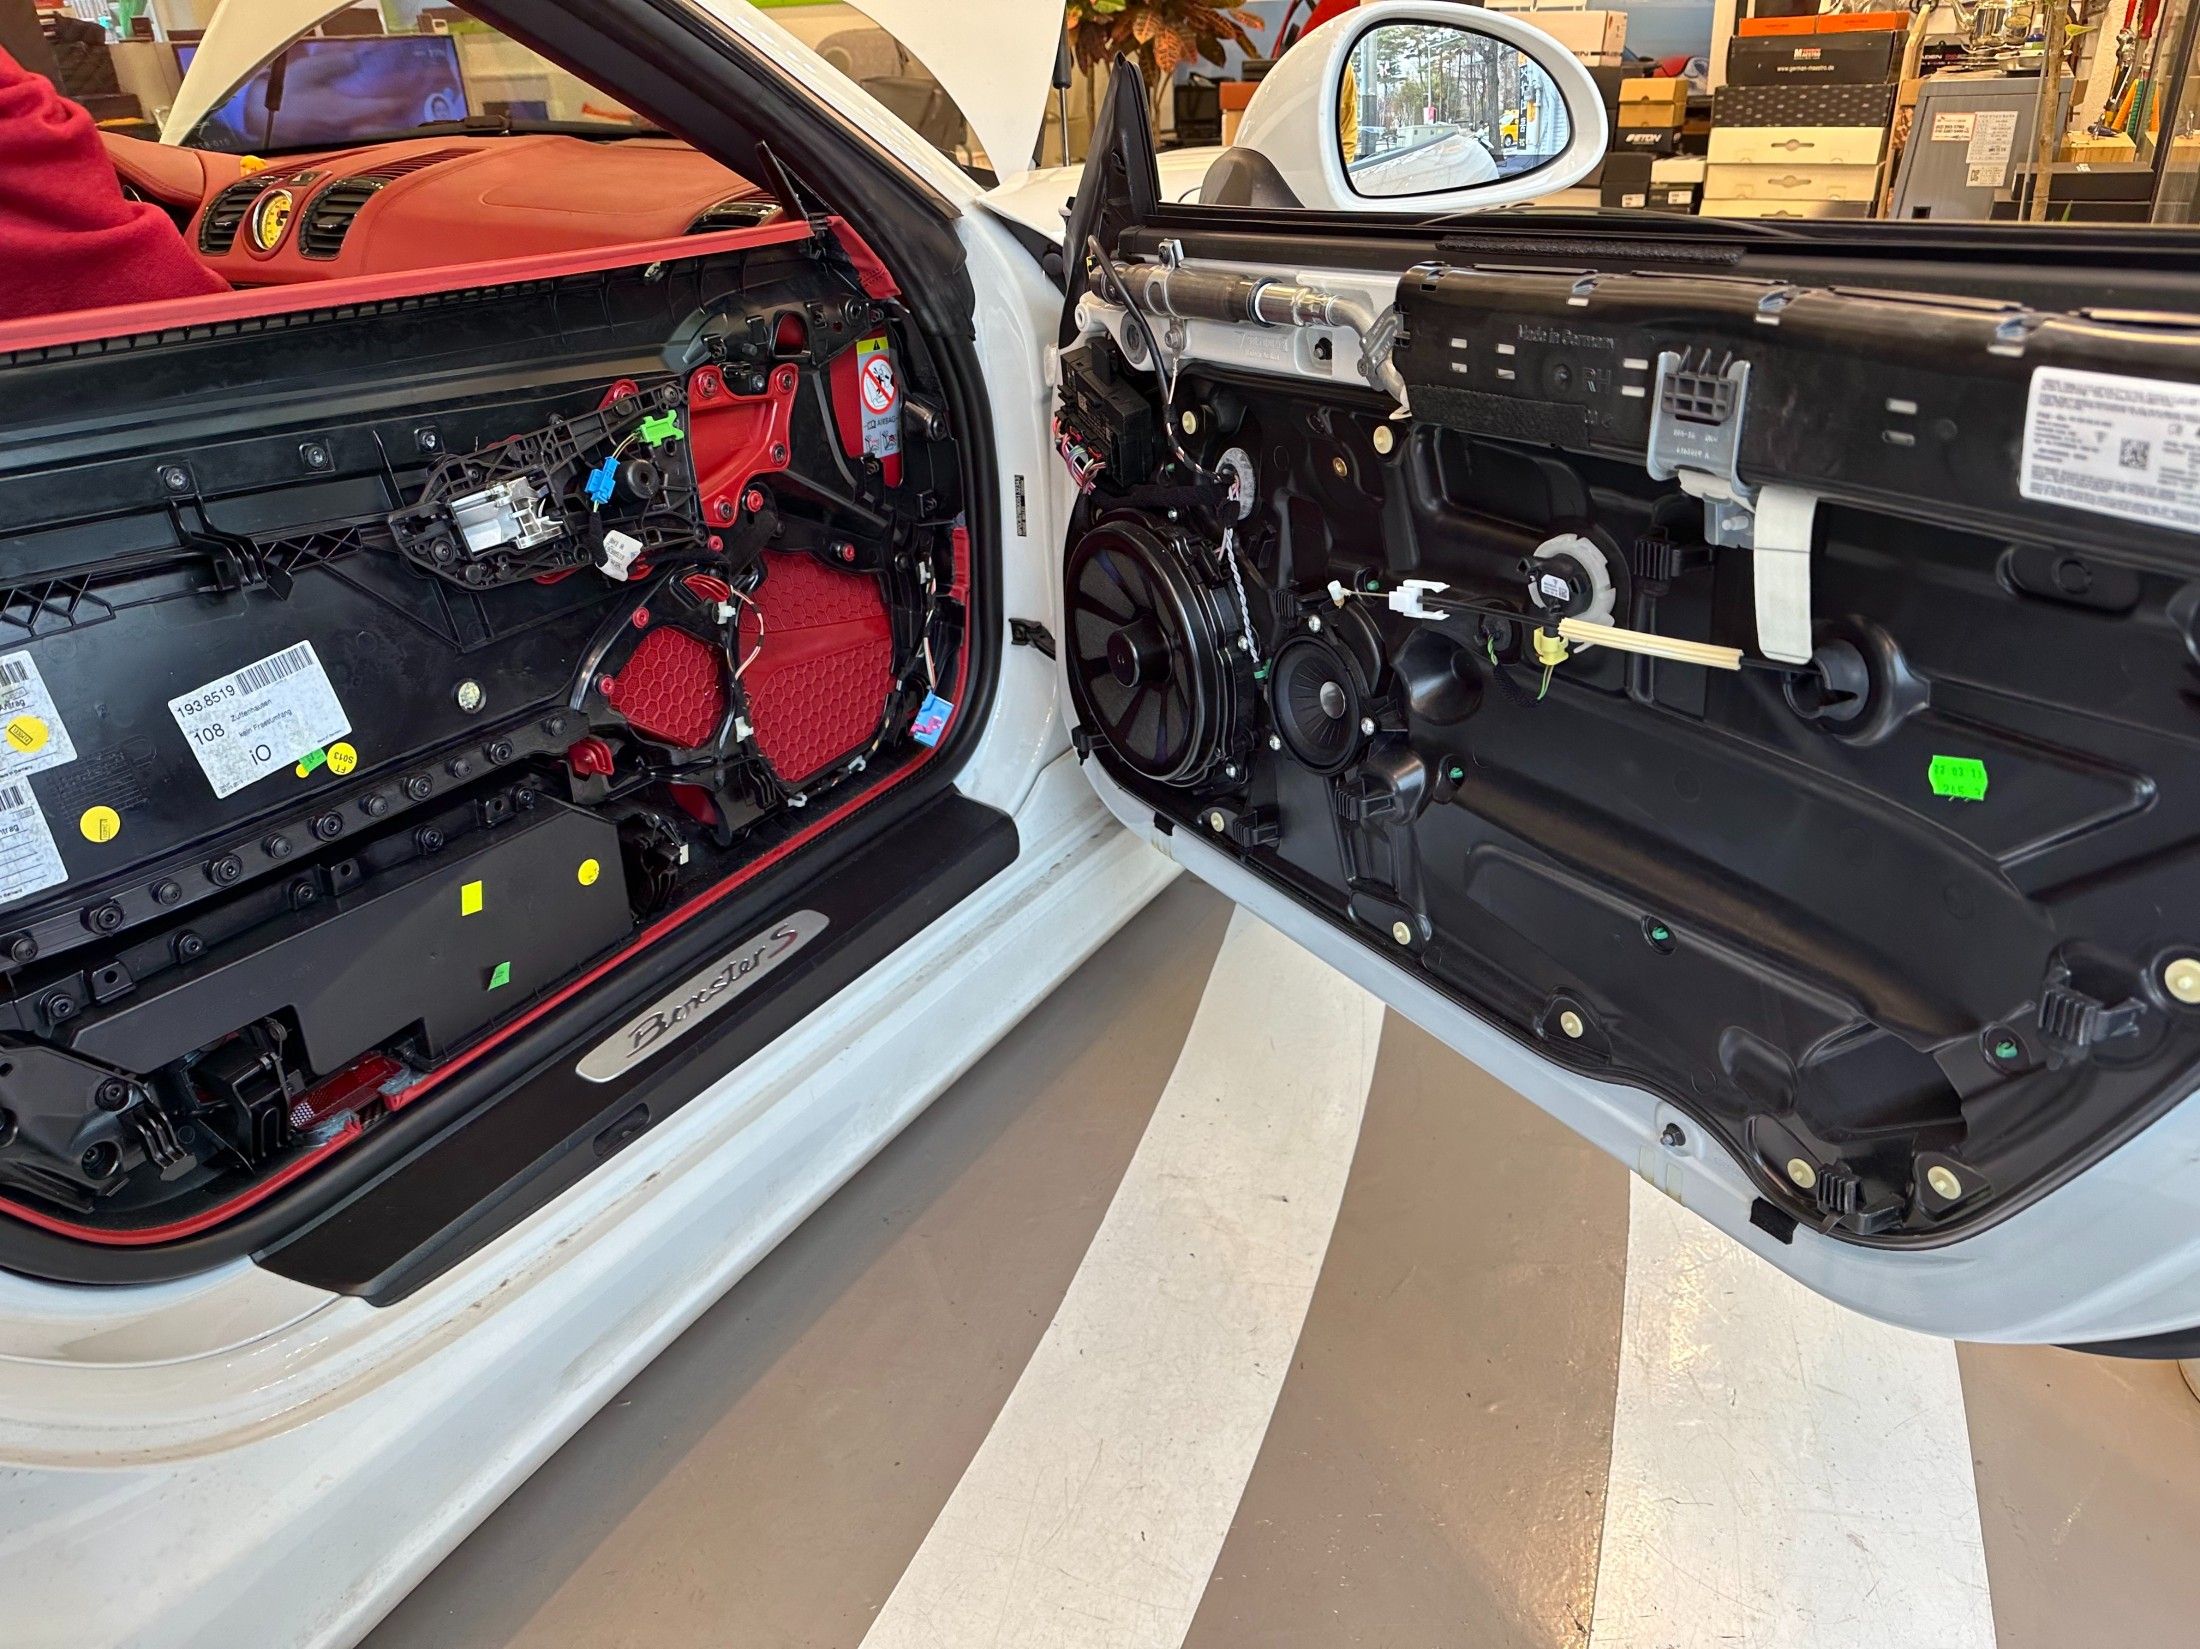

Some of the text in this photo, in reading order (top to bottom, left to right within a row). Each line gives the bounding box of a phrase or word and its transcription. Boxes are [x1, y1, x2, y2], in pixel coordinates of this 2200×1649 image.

[176, 685, 236, 719] 193.8519
[193, 723, 226, 746] 108
[248, 744, 272, 765] iO
[333, 751, 355, 764] S013
[334, 764, 347, 774] FT
[625, 922, 799, 1059] Boxster S
